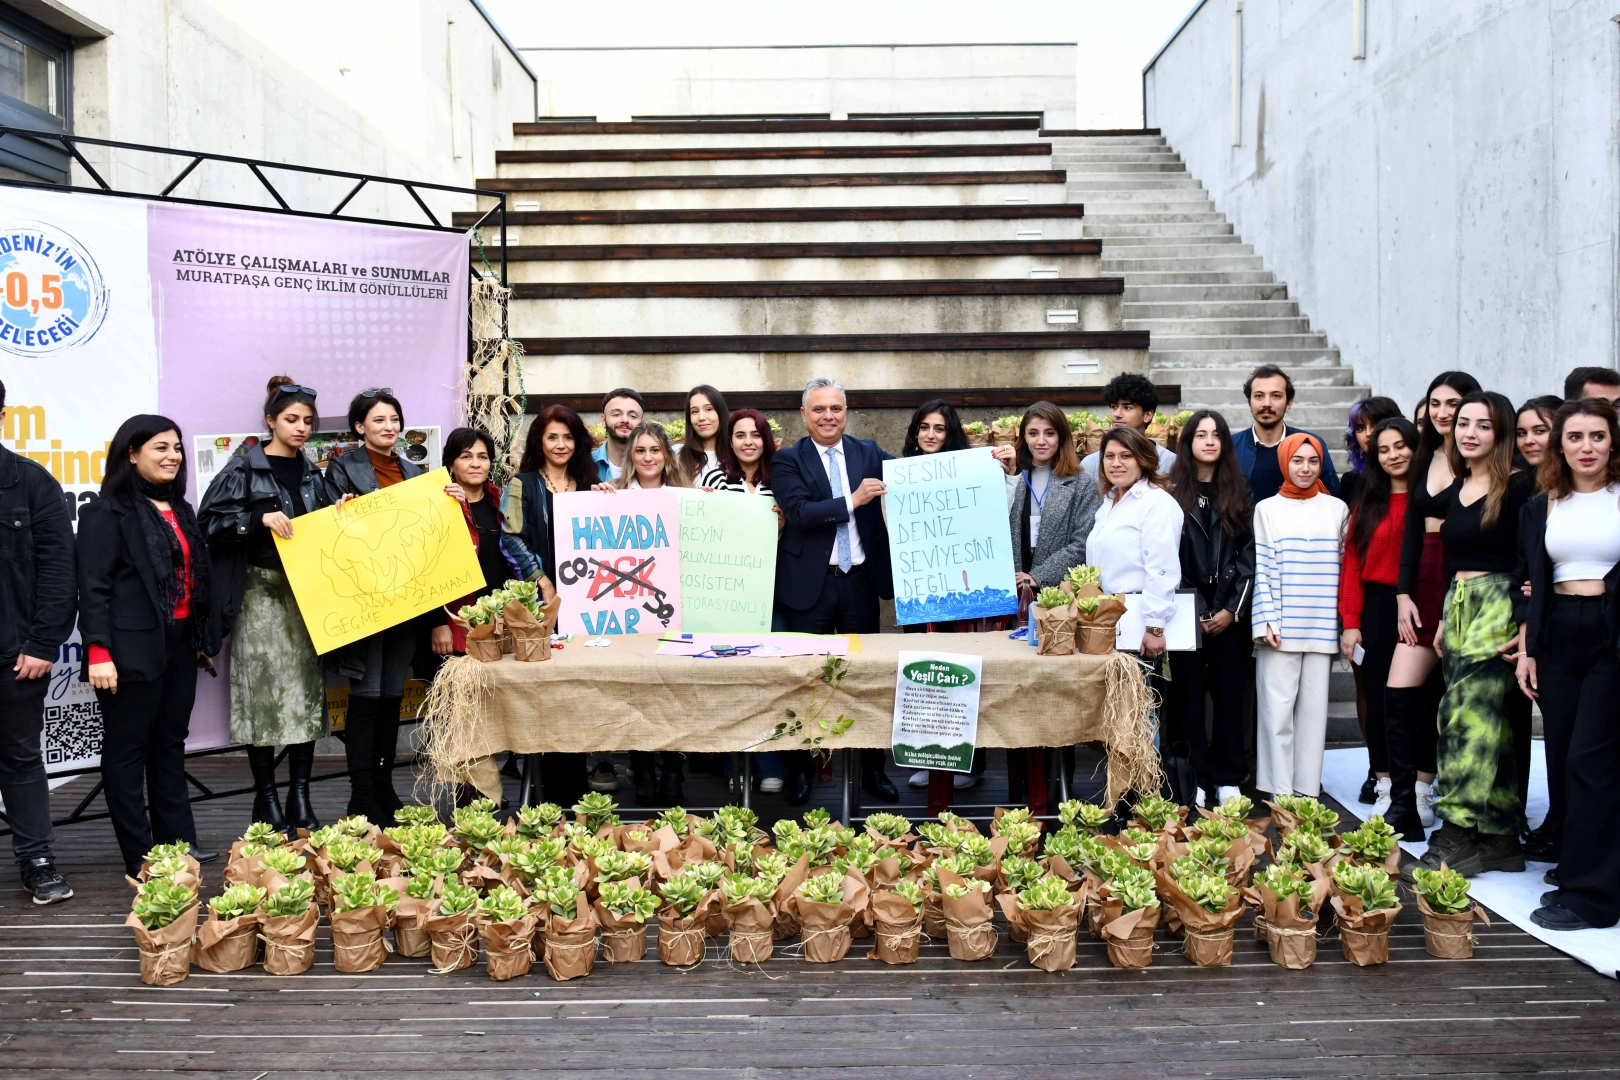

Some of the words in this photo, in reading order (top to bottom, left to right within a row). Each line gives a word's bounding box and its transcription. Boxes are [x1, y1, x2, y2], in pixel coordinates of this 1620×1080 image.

[172, 248, 236, 266] ATÖLYE
[240, 255, 348, 276] ÇALIŞMALARI
[352, 266, 368, 276] ve
[371, 266, 450, 284] SUNUMLAR
[176, 269, 270, 288] MURATPAŞA
[274, 276, 313, 292] GENÇ
[316, 278, 356, 293] İKLİM
[360, 282, 448, 300] GÖNÜLLÜLERİ
[894, 456, 958, 485] SESİNİ
[894, 486, 982, 516] YÜKSELT
[572, 514, 670, 550] HAVADA
[896, 515, 957, 544] DENİZ
[900, 536, 994, 574] SEVİYESİNİ
[900, 572, 957, 598] DEĞİL
[580, 608, 640, 636] VAR
[910, 670, 934, 684] Yeşil
[937, 673, 958, 684] Çatı
[930, 664, 950, 672] Neden
